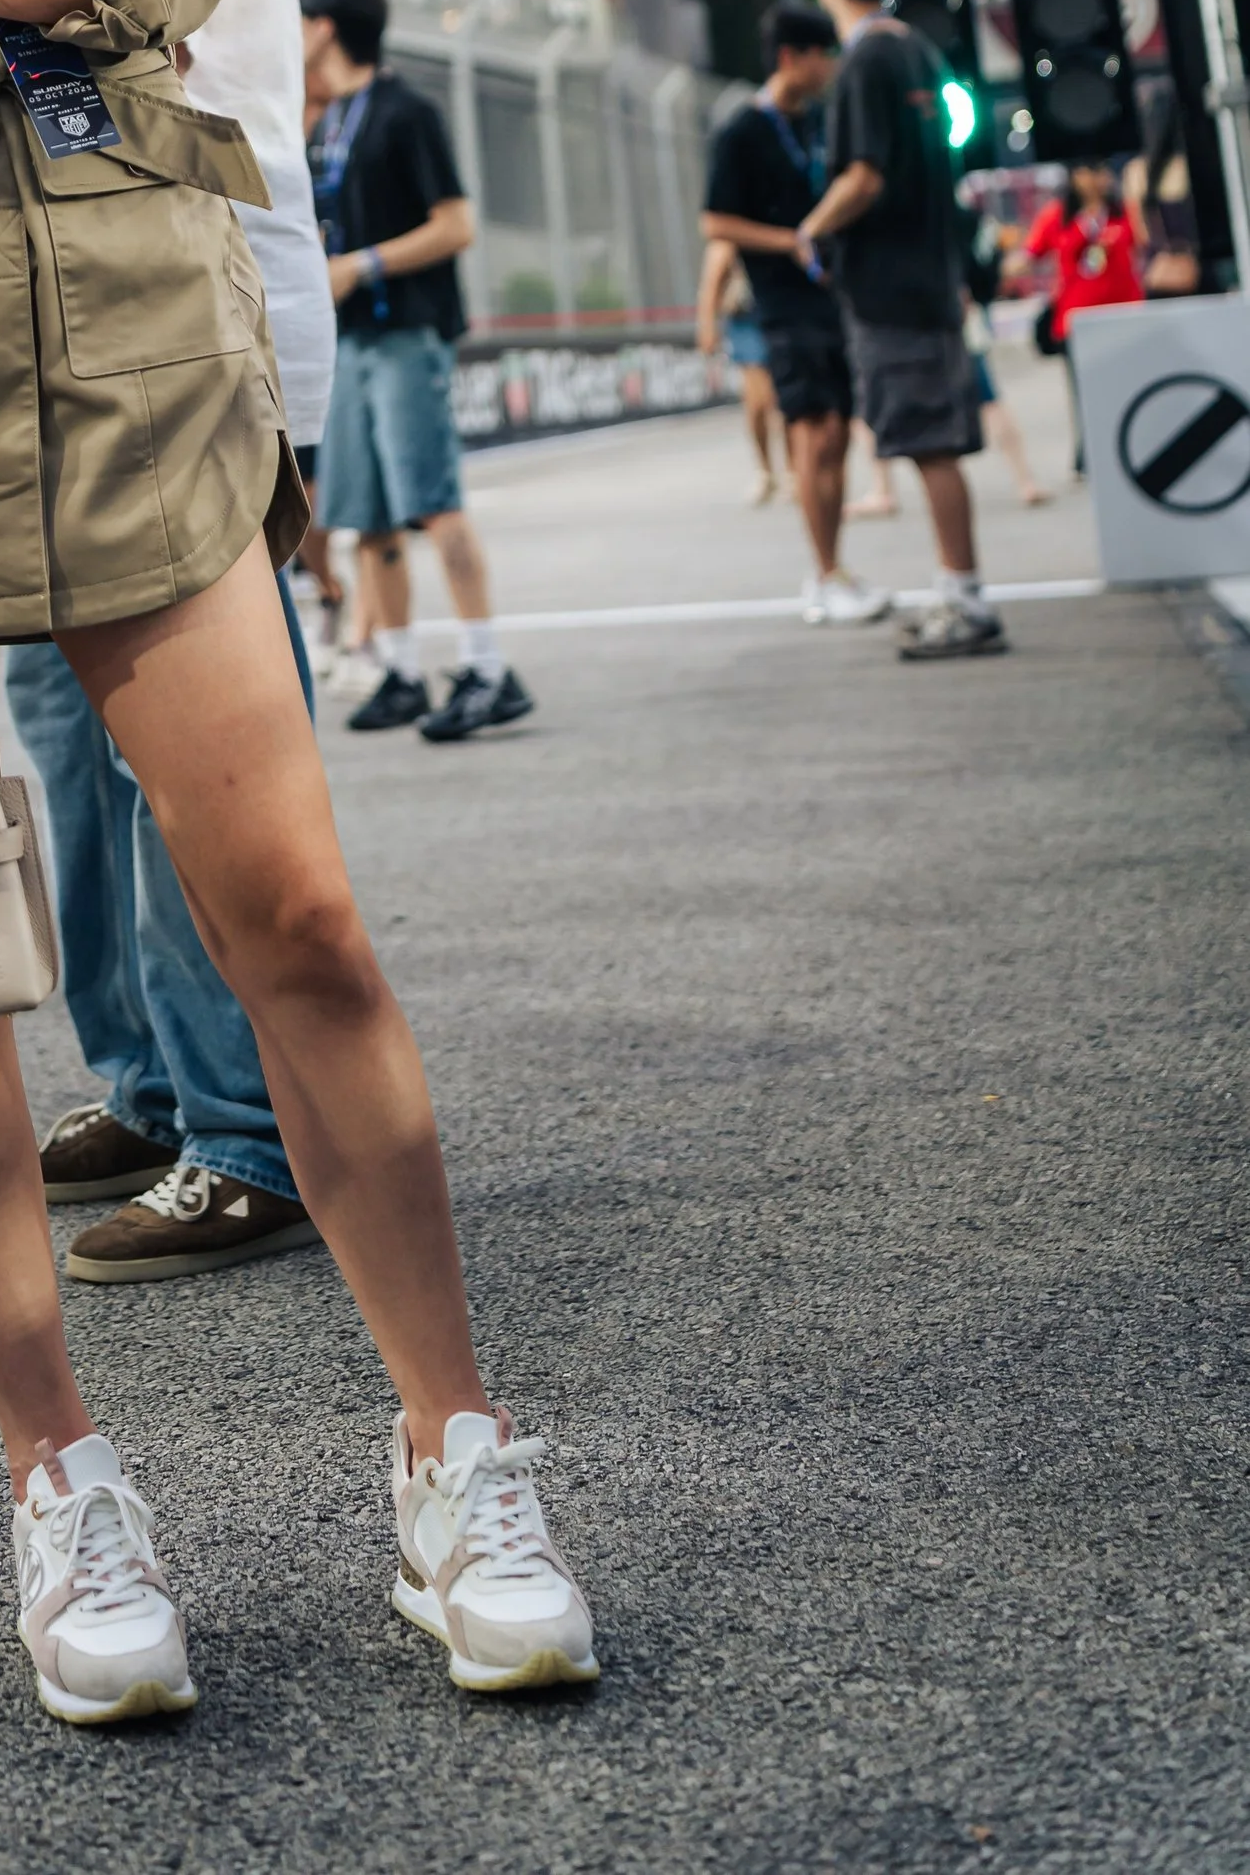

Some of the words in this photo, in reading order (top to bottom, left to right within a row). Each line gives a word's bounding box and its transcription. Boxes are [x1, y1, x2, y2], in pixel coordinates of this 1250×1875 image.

[29, 85, 92, 103] 05.OCT.2025
[33, 81, 81, 95] SUNDAY
[61, 114, 84, 125] TAG
[63, 121, 89, 135] HEUER
